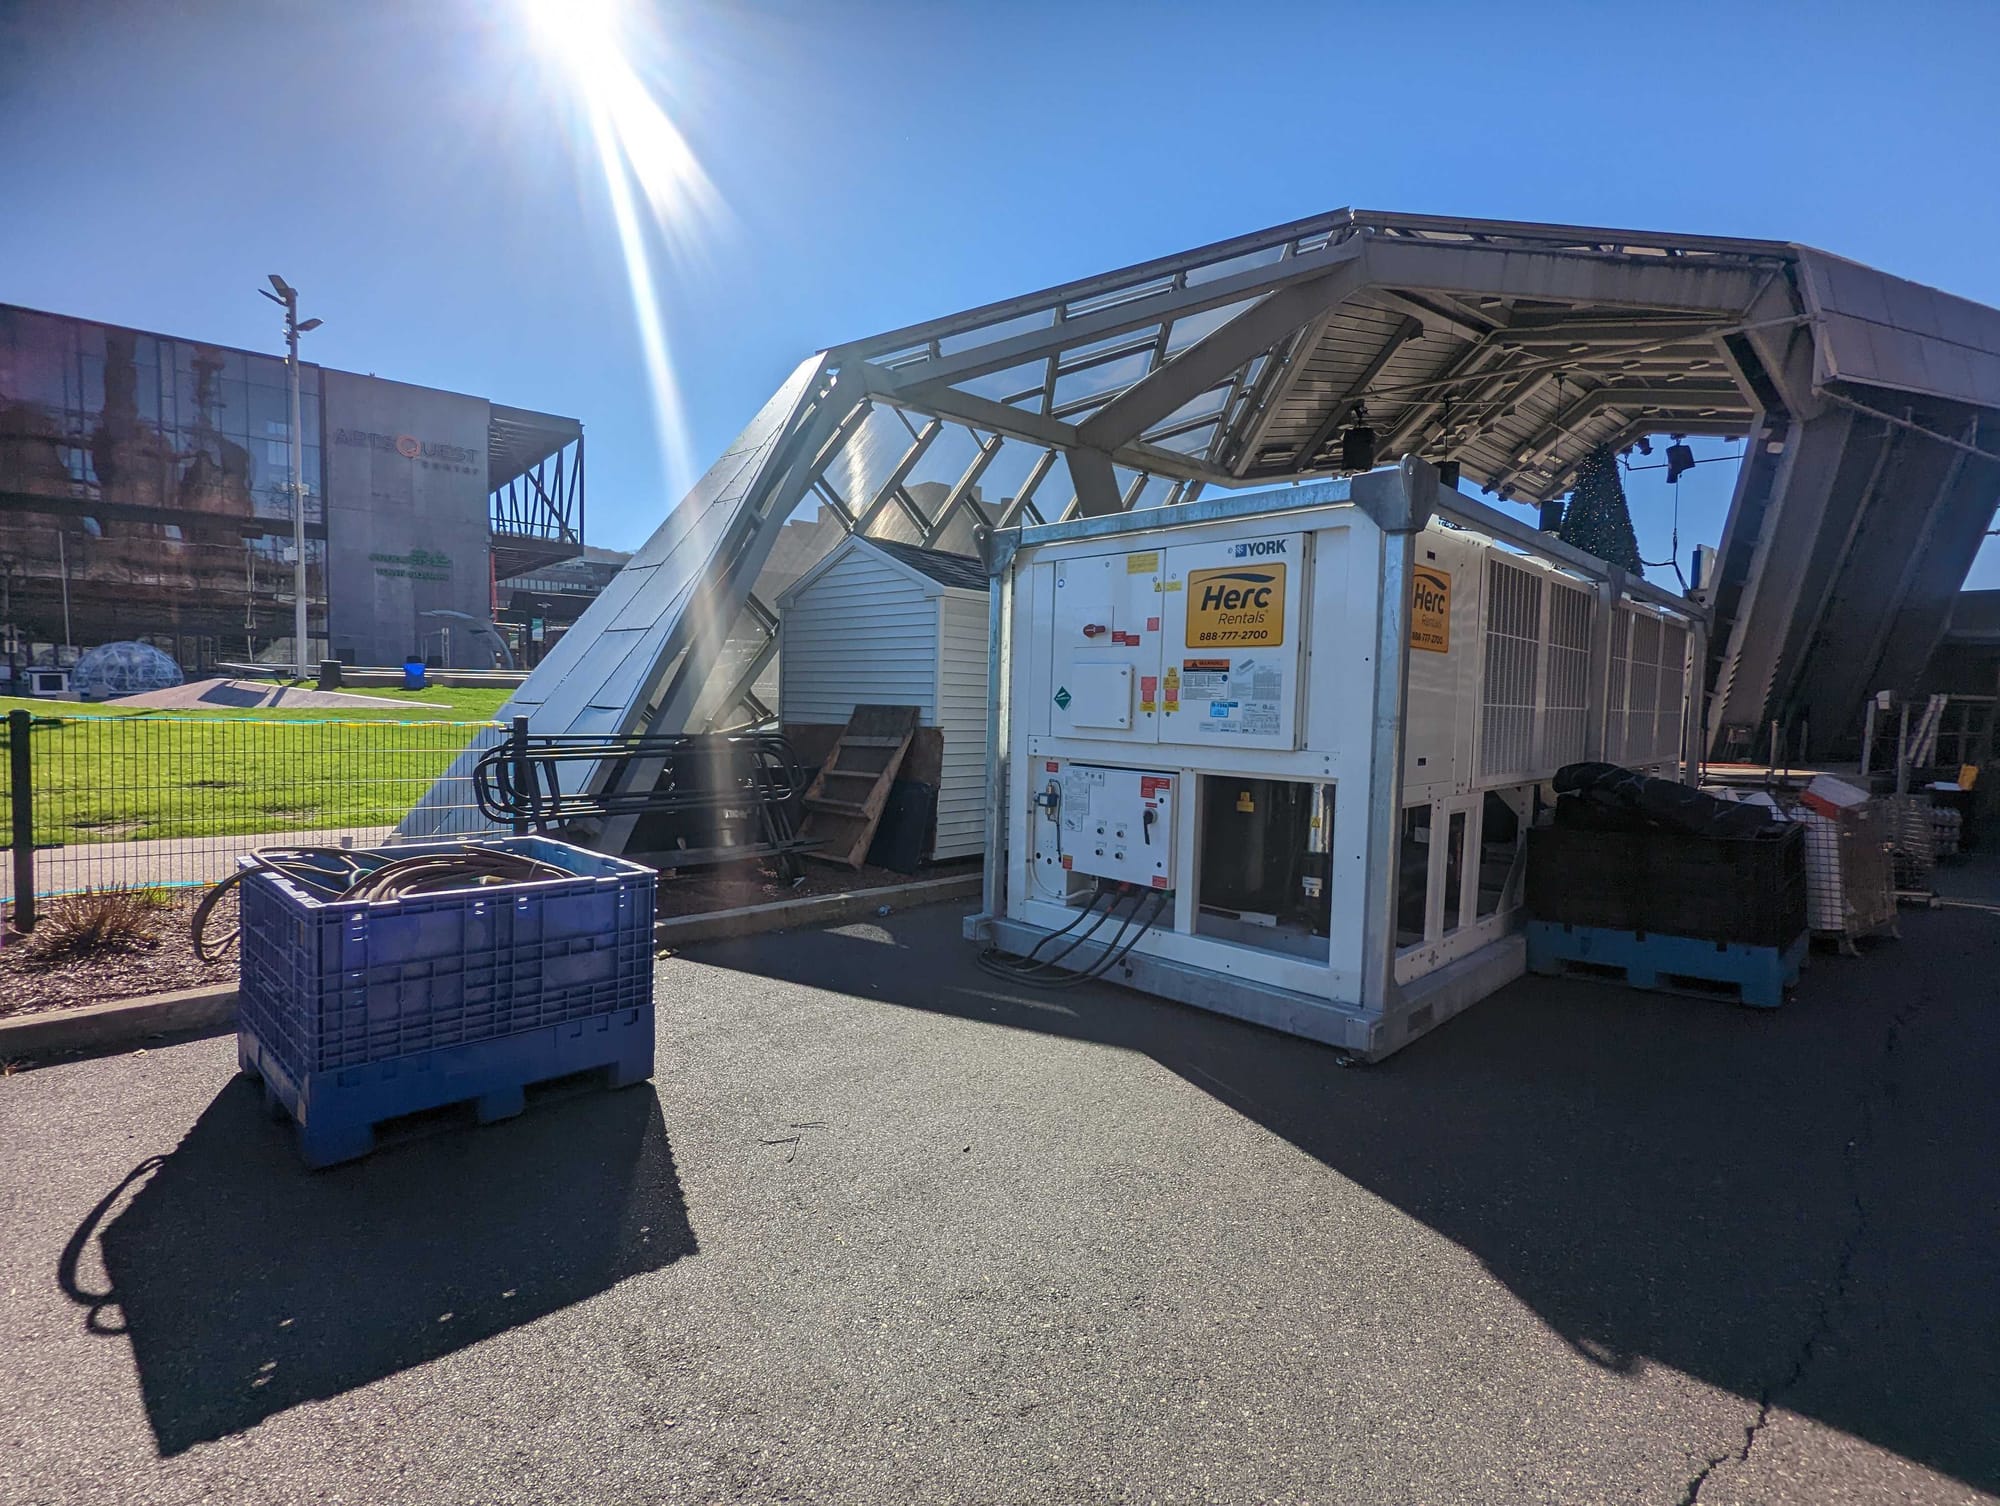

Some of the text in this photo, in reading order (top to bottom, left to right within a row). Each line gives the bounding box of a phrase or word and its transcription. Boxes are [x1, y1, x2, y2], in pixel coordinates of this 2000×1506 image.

[1247, 539, 1287, 556] YORK
[1201, 585, 1272, 611] Herc
[1413, 582, 1446, 615] Herc
[1218, 611, 1265, 625] Rentals
[1199, 630, 1269, 641] 888-777-2700
